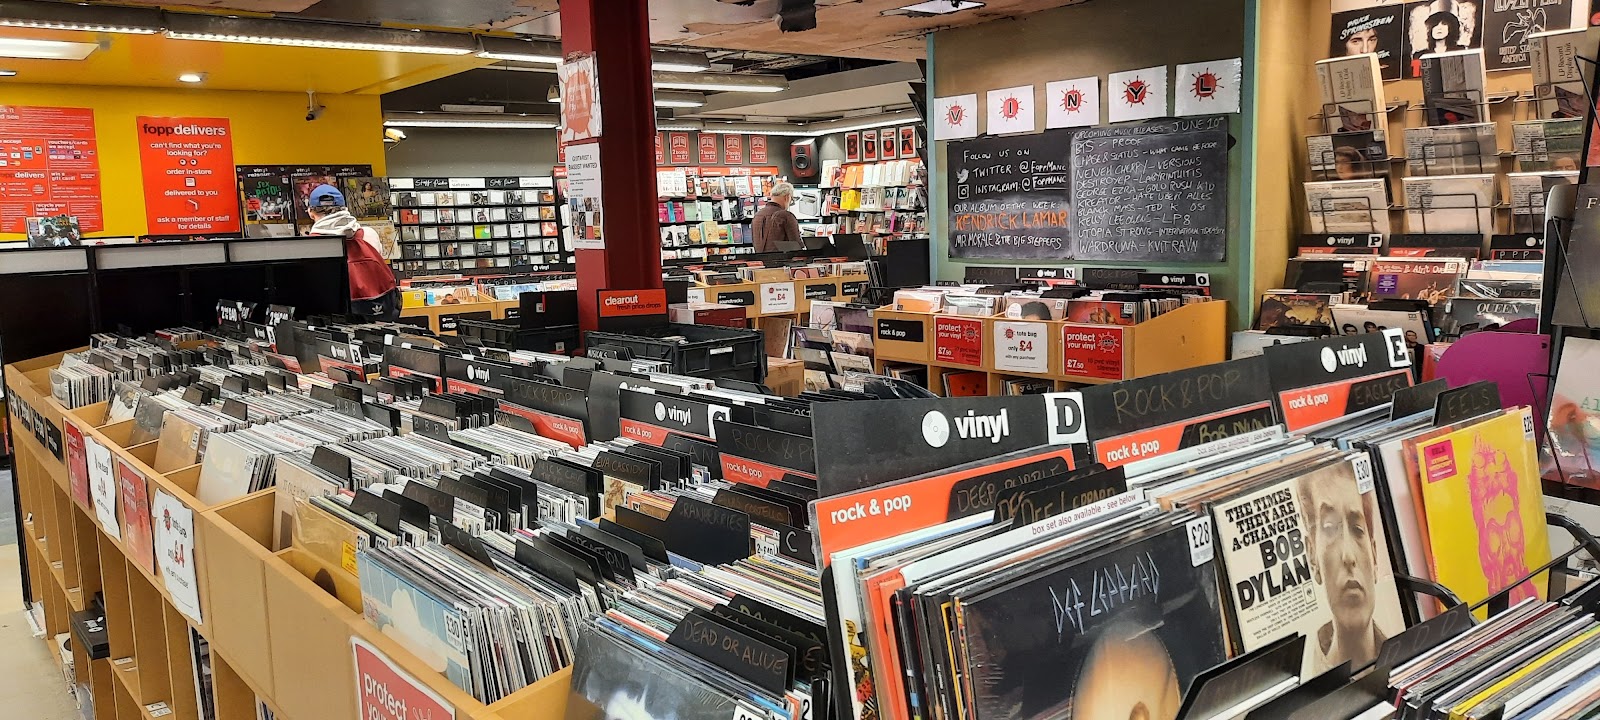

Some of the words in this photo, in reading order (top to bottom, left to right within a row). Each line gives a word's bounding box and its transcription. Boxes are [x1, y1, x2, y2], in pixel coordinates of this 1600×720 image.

[1340, 15, 1394, 40] SPRINGSTEEN
[950, 110, 961, 122] V
[1008, 102, 1013, 114] I
[1068, 93, 1078, 107] N
[1128, 87, 1141, 102] Y
[1199, 78, 1212, 92] L
[143, 123, 226, 137] foppdelivers
[1075, 140, 1094, 155] BTS
[1112, 138, 1143, 148] PROOF
[964, 150, 991, 163] FOLLOW
[1074, 153, 1101, 168] CHASE
[1111, 150, 1138, 161] STATUS
[1076, 165, 1112, 180] NENEH
[1115, 160, 1148, 174] CHERRY
[1157, 157, 1202, 170] VERSIONS
[1076, 175, 1130, 191] DESTROYER
[1077, 188, 1108, 200] GEORGE
[1112, 185, 1136, 195] EZRA
[1145, 182, 1167, 194] GOLD
[1169, 181, 1192, 191] RUSH
[1196, 181, 1215, 191] KID
[954, 203, 968, 212] OUR
[971, 203, 997, 213] ALBUM
[1000, 202, 1009, 210] OF
[1078, 196, 1121, 208] KREATOR
[1132, 192, 1153, 201] HATE
[1186, 192, 1213, 200] ALLES
[1078, 206, 1109, 217] BLANCK
[1114, 204, 1135, 212] MASS
[1145, 203, 1163, 211] TED
[956, 212, 1018, 230] KENDRICK
[1023, 210, 1067, 228] LAMAR
[955, 234, 967, 247] MR
[968, 233, 993, 247] MORALE
[1013, 235, 1026, 246] BIG
[1027, 236, 1062, 249] STEPPERS
[1079, 240, 1138, 253] WARDRUNA
[1149, 237, 1198, 254] KVITRAVN
[1337, 236, 1354, 245] vinyl
[1370, 237, 1380, 246] P
[1198, 276, 1206, 284] O
[605, 295, 638, 306] clearout
[631, 304, 645, 312] price
[646, 302, 661, 311] drops
[1477, 303, 1522, 313] QUEEN
[938, 324, 961, 332] protect
[1067, 332, 1096, 342] protect
[938, 347, 951, 356] £7.50
[1019, 340, 1033, 351] £4
[1337, 342, 1368, 368] vinyl
[1390, 335, 1406, 362] E
[475, 367, 490, 383] vinyl
[1113, 384, 1178, 423] ROCK
[1180, 380, 1193, 408] &
[1198, 370, 1240, 400] POP
[1289, 396, 1306, 410] rock
[1307, 396, 1313, 407] &
[1315, 393, 1328, 406] pop
[1355, 378, 1400, 406] EAGLES
[1447, 389, 1491, 418] EELS
[668, 405, 691, 426] vinyl
[954, 408, 1009, 444] vinyl
[1054, 398, 1081, 435] D
[625, 426, 636, 434] rock
[642, 430, 651, 439] pop
[1199, 424, 1228, 443] BOB
[732, 429, 776, 455] ROCK
[783, 439, 793, 459] &
[1107, 444, 1131, 462] rock
[1131, 443, 1139, 456] &
[1142, 440, 1160, 458] pop
[596, 457, 610, 467] EVA
[612, 460, 644, 473] CASSIDY
[726, 462, 742, 472] rock
[743, 465, 748, 474] &
[749, 467, 762, 479] pop
[1356, 460, 1370, 480] £30
[831, 503, 866, 525] rock
[869, 499, 881, 516] &
[884, 494, 912, 517] pop
[1032, 525, 1045, 535] box
[1046, 521, 1057, 530] set
[1058, 515, 1072, 527] also
[1074, 506, 1101, 521] available
[1106, 500, 1118, 510] see
[1119, 493, 1136, 507] below
[1225, 503, 1253, 523] THE
[1255, 488, 1292, 510] TIMES
[1236, 510, 1272, 534] THEY
[1272, 502, 1296, 521] ARE
[1191, 521, 1210, 549] £28
[1259, 528, 1304, 570] BOB
[1236, 555, 1311, 610] DYLAN
[1048, 578, 1084, 639] DEF
[1090, 552, 1160, 617] LEPPARD
[683, 619, 718, 647] DEAD
[722, 636, 739, 657] OR
[742, 647, 789, 676] ALIVE
[364, 673, 407, 720] protect
